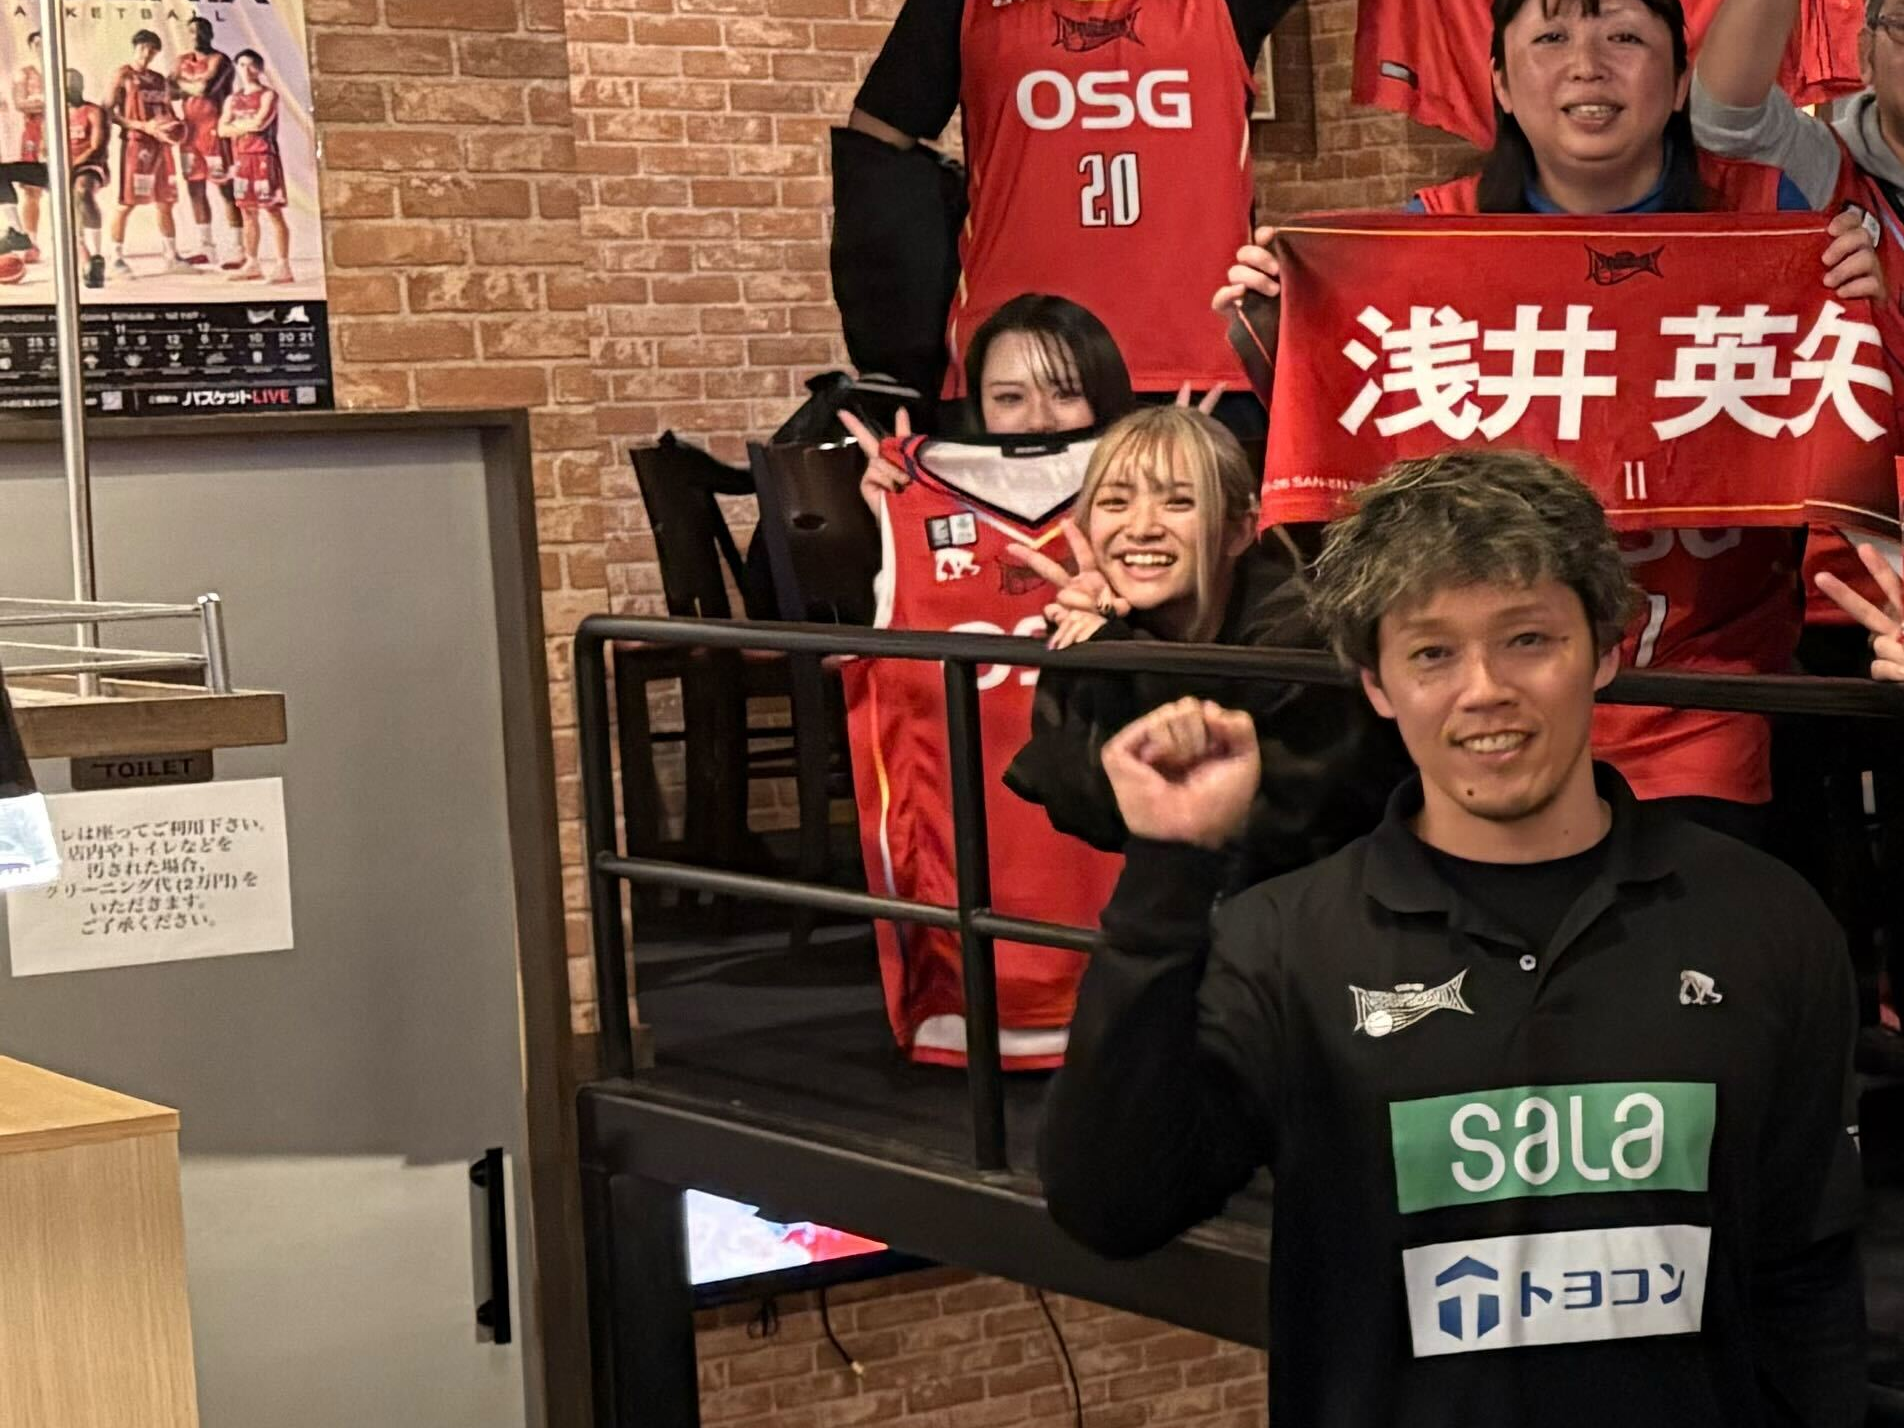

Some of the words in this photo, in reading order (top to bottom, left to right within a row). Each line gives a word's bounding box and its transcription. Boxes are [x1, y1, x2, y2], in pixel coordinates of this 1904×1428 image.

[1016, 70, 1193, 130] OSG
[1079, 151, 1142, 228] 20
[1337, 304, 1617, 441] 浅井
[1652, 300, 1893, 442] 英矢
[1624, 461, 1648, 500] 11
[97, 758, 194, 778] TOILET
[1520, 1263, 1686, 1319] トヨコン
